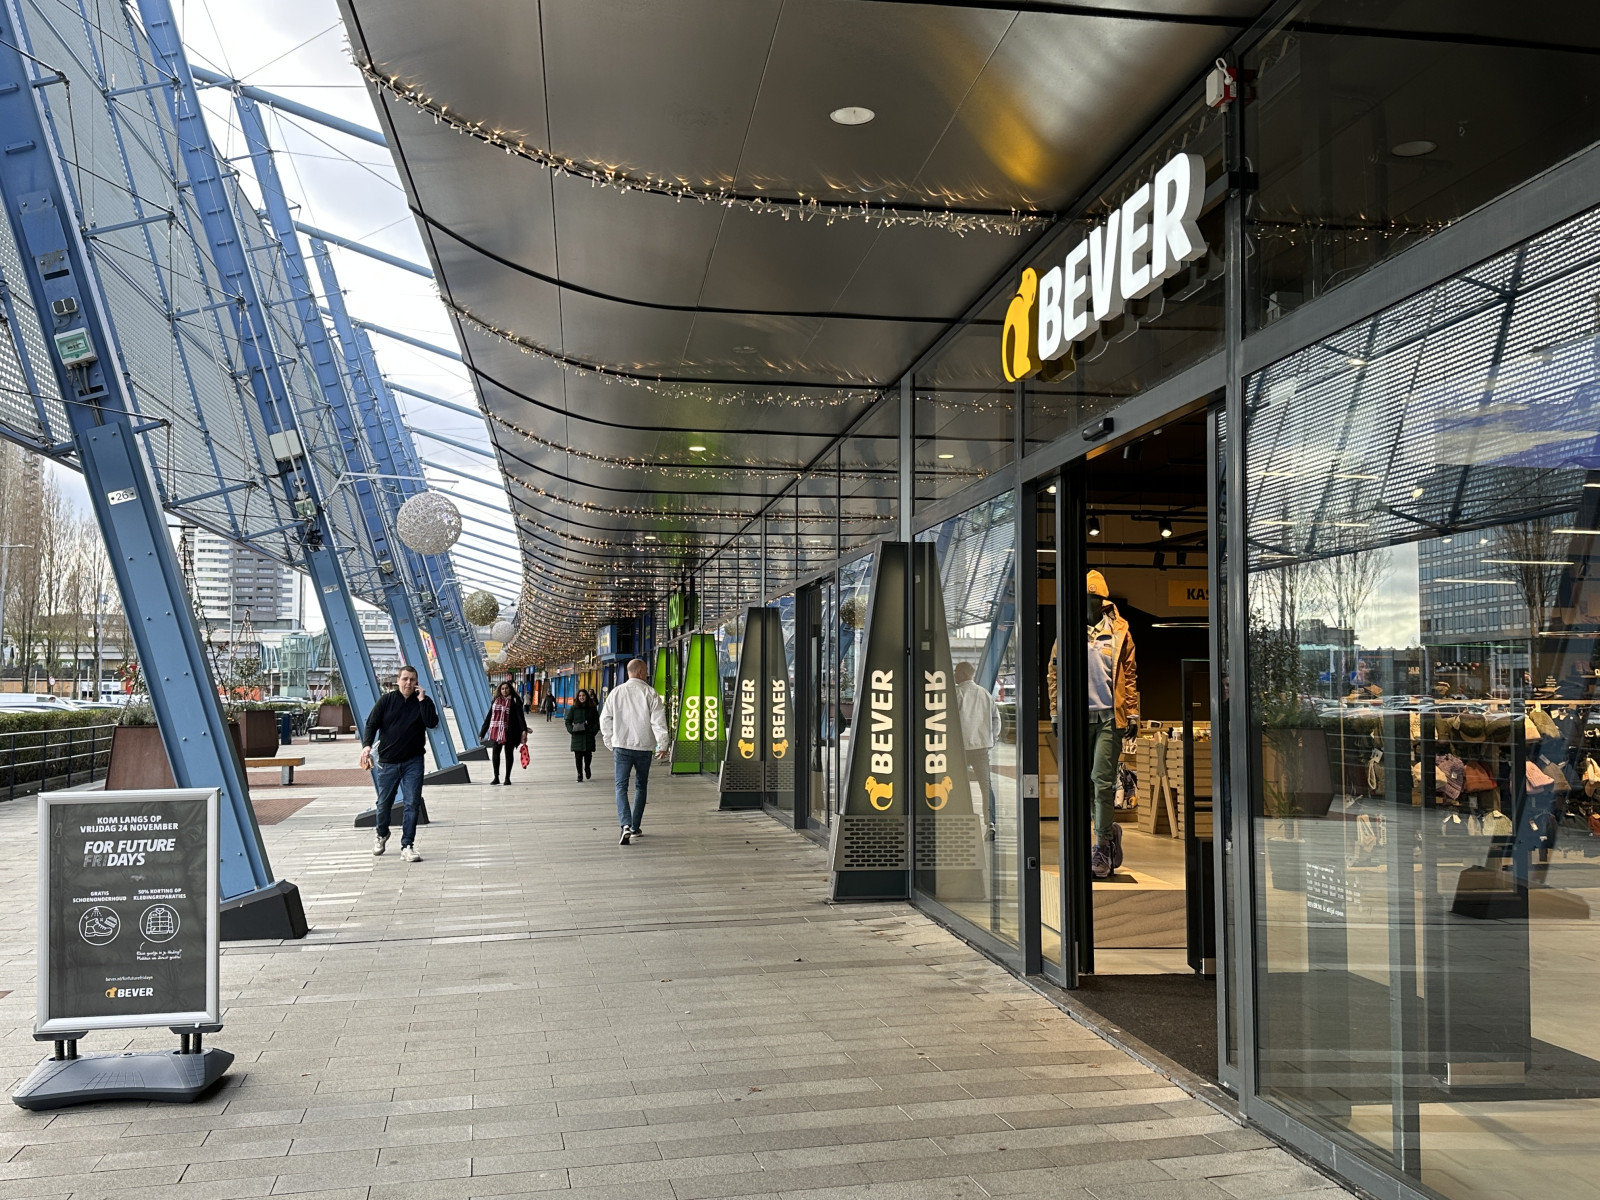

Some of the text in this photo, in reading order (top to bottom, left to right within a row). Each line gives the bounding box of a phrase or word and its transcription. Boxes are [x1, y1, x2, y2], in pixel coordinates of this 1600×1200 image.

[1038, 152, 1207, 361] BEVER
[116, 490, 129, 501] 26
[741, 679, 755, 739] BEVER
[685, 696, 700, 741] casa
[871, 669, 894, 775] BEVER
[97, 815, 162, 825] KOM LANGS OP
[80, 823, 178, 833] VRIJDAG 24 NOVEMBER
[83, 838, 176, 854] FOR FUTURE
[72, 895, 127, 903] SCHOENONDERHOUD
[133, 893, 187, 901] KLEDINGREPARATIES
[117, 987, 154, 998] BEVER
